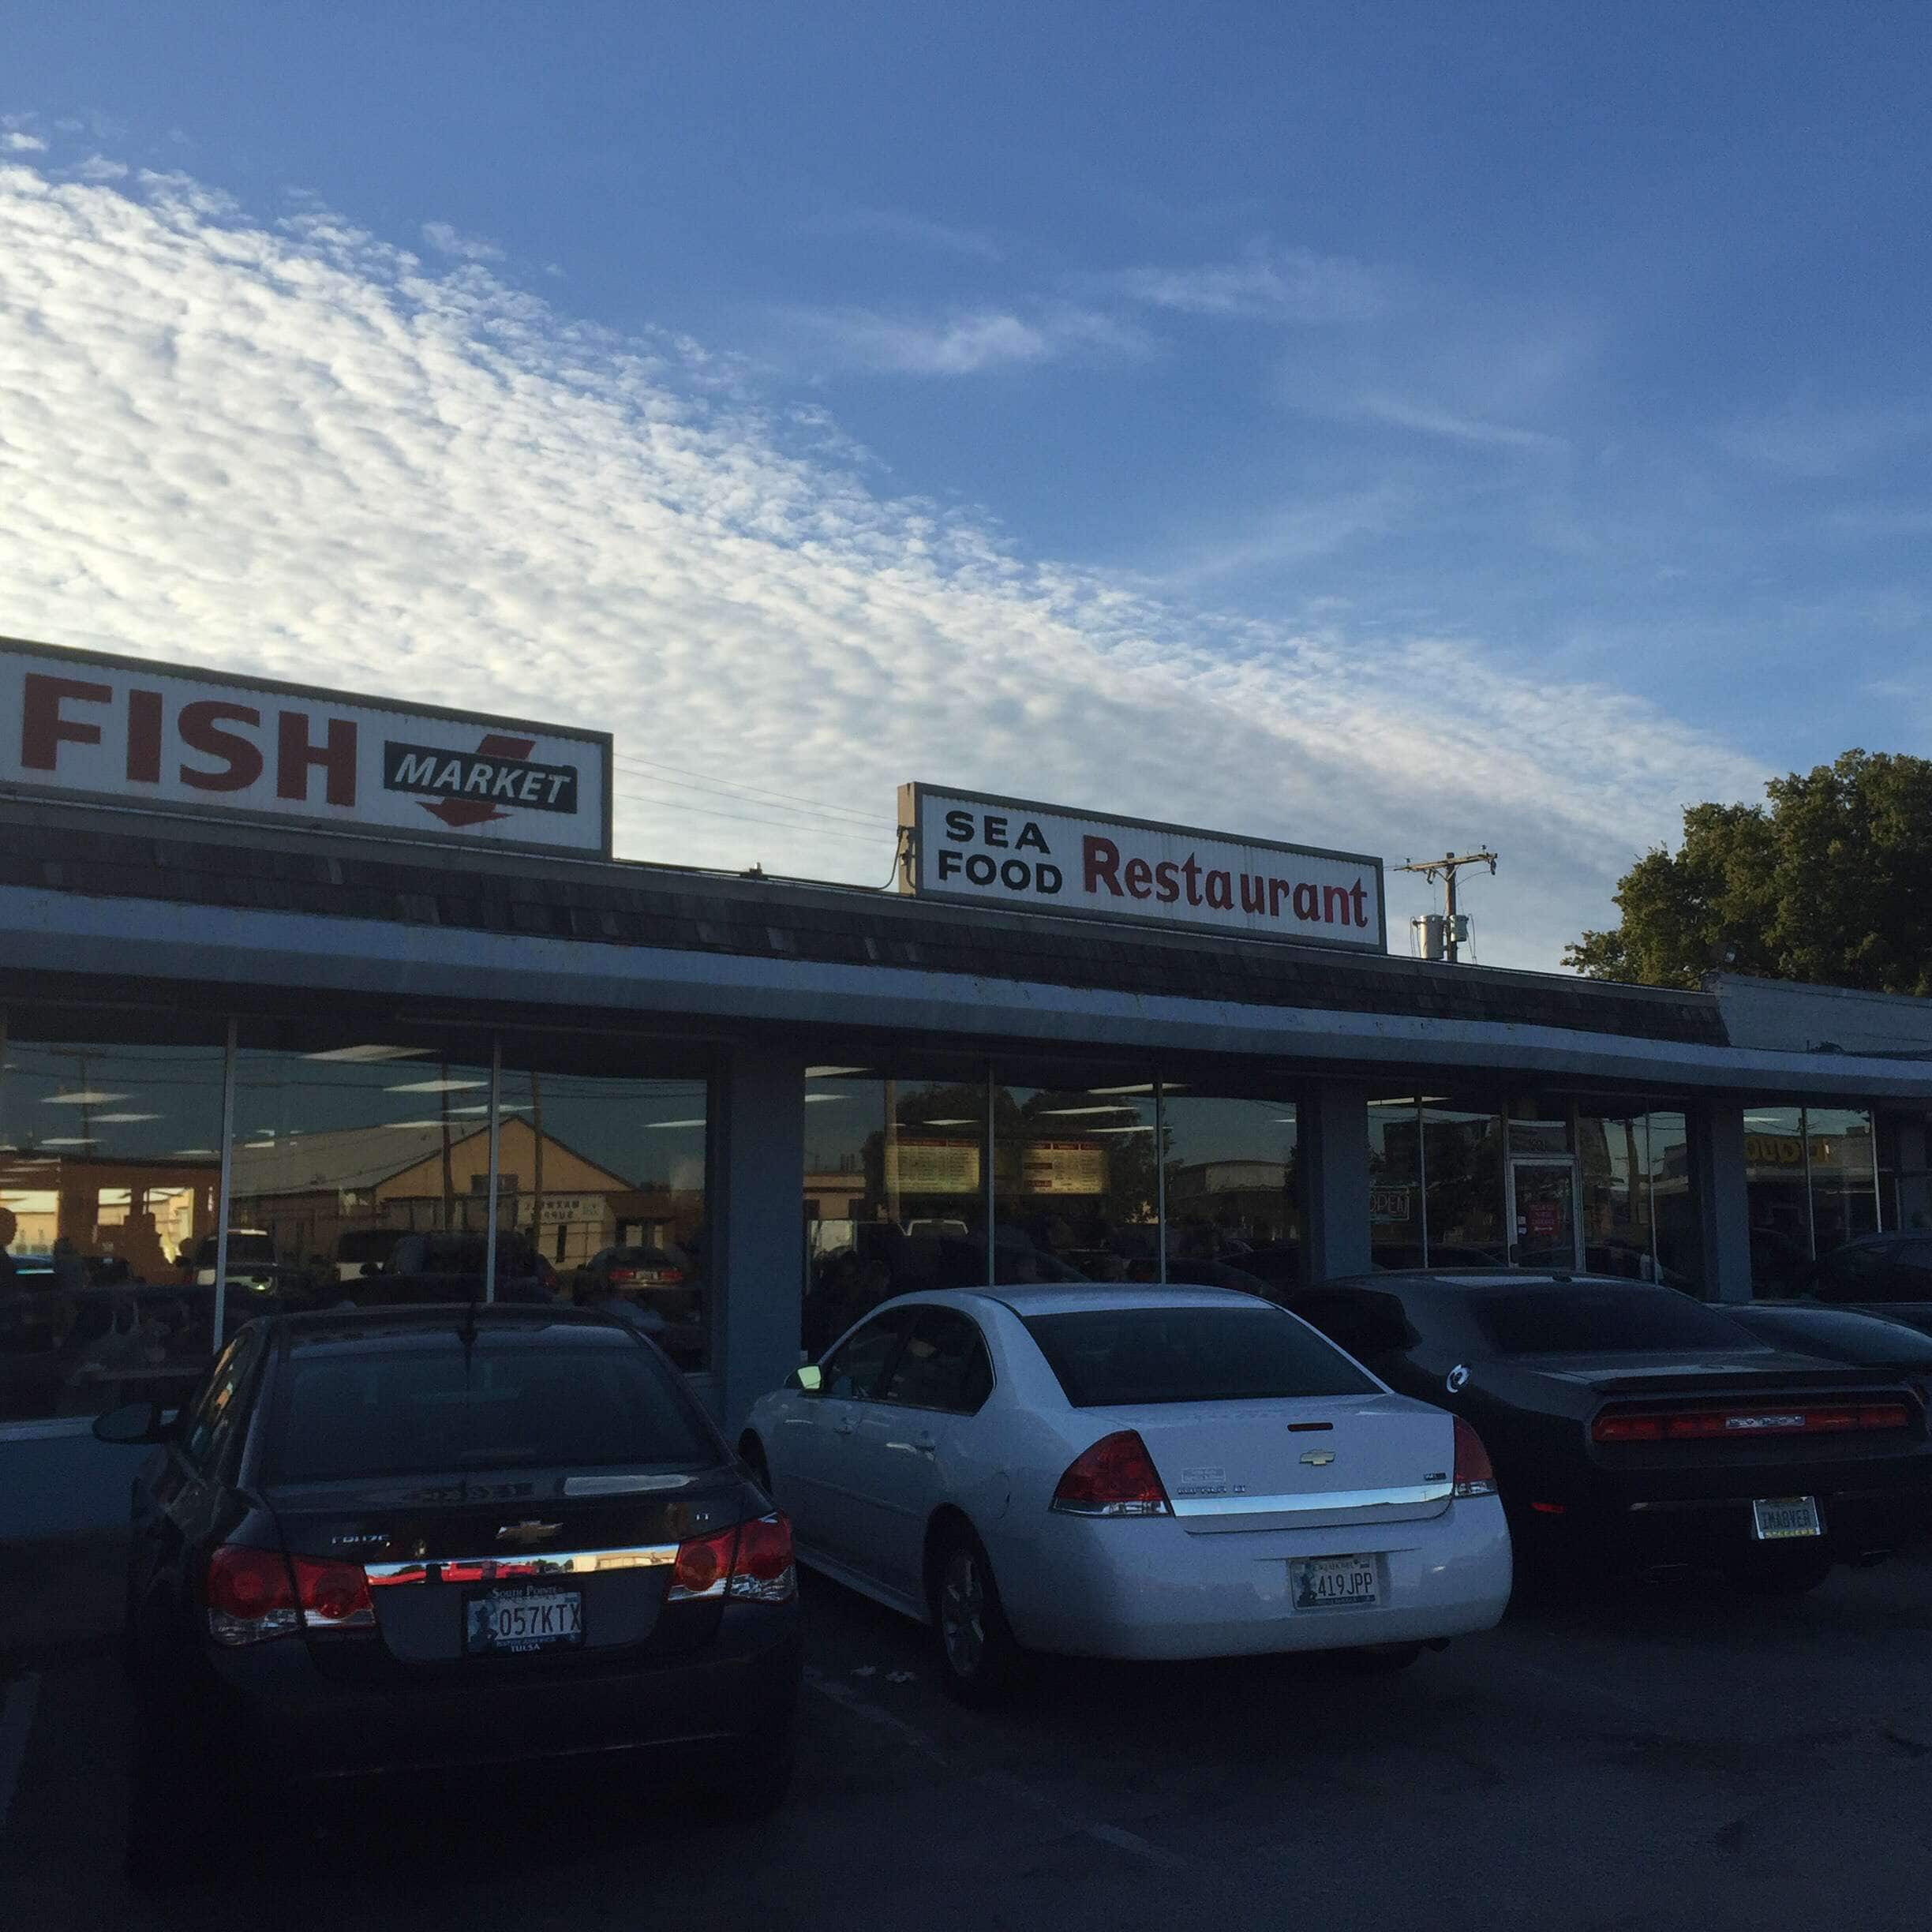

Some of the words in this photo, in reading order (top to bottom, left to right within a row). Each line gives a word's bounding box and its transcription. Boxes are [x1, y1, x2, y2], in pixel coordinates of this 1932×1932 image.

[21, 672, 358, 807] FISH
[394, 753, 572, 804] MARKET
[945, 810, 1051, 855] SEA
[937, 849, 1063, 895] FOOD
[1082, 833, 1369, 929] Restaurant
[1318, 1572, 1373, 1597] 419JPP
[499, 1603, 582, 1637] 057KTX
[511, 1642, 541, 1654] TULSA
